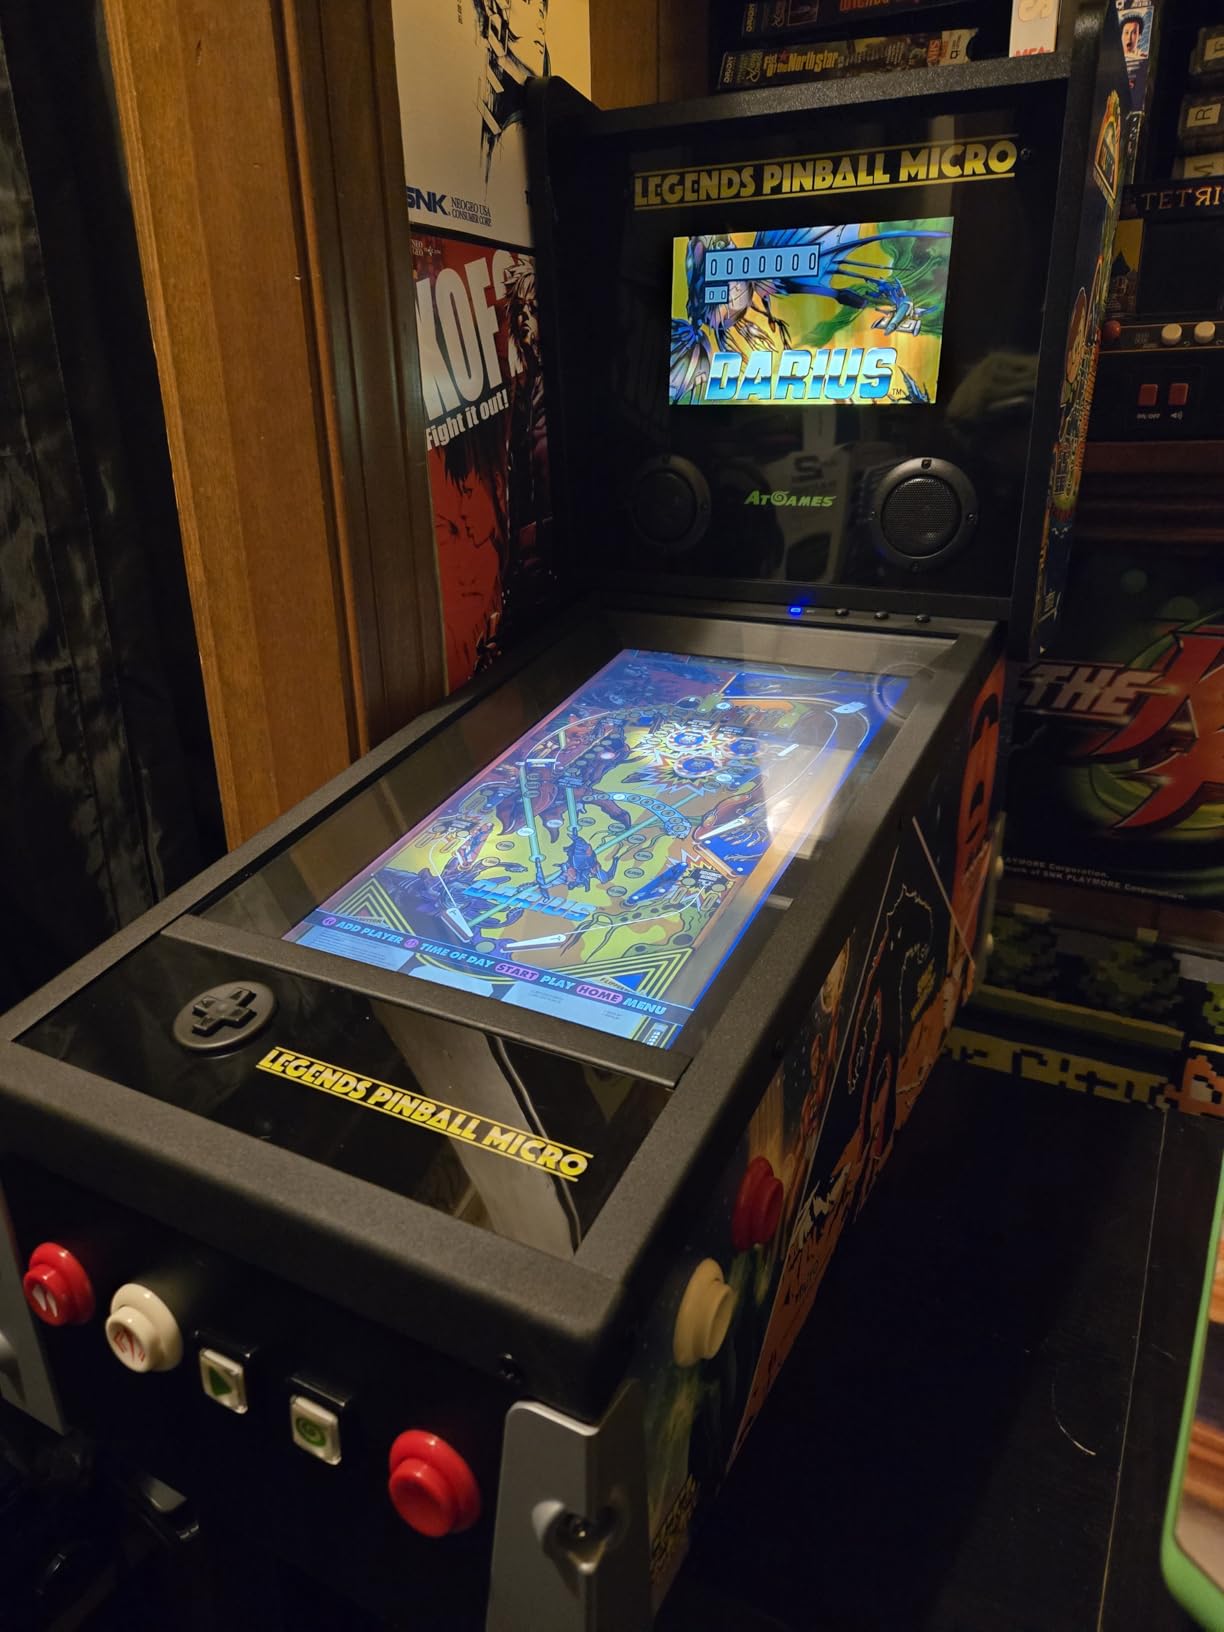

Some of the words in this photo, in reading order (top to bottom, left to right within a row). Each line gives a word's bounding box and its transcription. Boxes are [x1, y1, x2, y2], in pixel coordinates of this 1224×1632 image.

[1194, 106, 1213, 121] R
[635, 166, 756, 206] LEGENDS
[762, 152, 891, 194] PINBALL
[899, 139, 1018, 183] MICRO
[405, 185, 448, 216] SNK
[704, 346, 898, 401] DARIUS
[425, 414, 466, 450] Fight
[465, 402, 480, 430] it
[479, 388, 511, 421] out!
[1022, 662, 1165, 716] THE
[1005, 856, 1047, 869] AYMORE
[463, 879, 597, 922] DARIUS
[335, 921, 362, 933] ADD
[361, 927, 404, 944] PLAYER
[419, 942, 451, 957] TIME
[449, 951, 468, 961] OF
[466, 955, 496, 968] DAY
[496, 963, 538, 981] START
[540, 974, 576, 990] PLAY
[577, 984, 622, 1004] HOME
[622, 996, 668, 1016] MENU
[258, 1049, 373, 1099] LEGENDS
[366, 1085, 478, 1141] PINBALL
[482, 1125, 589, 1177] MICRO
